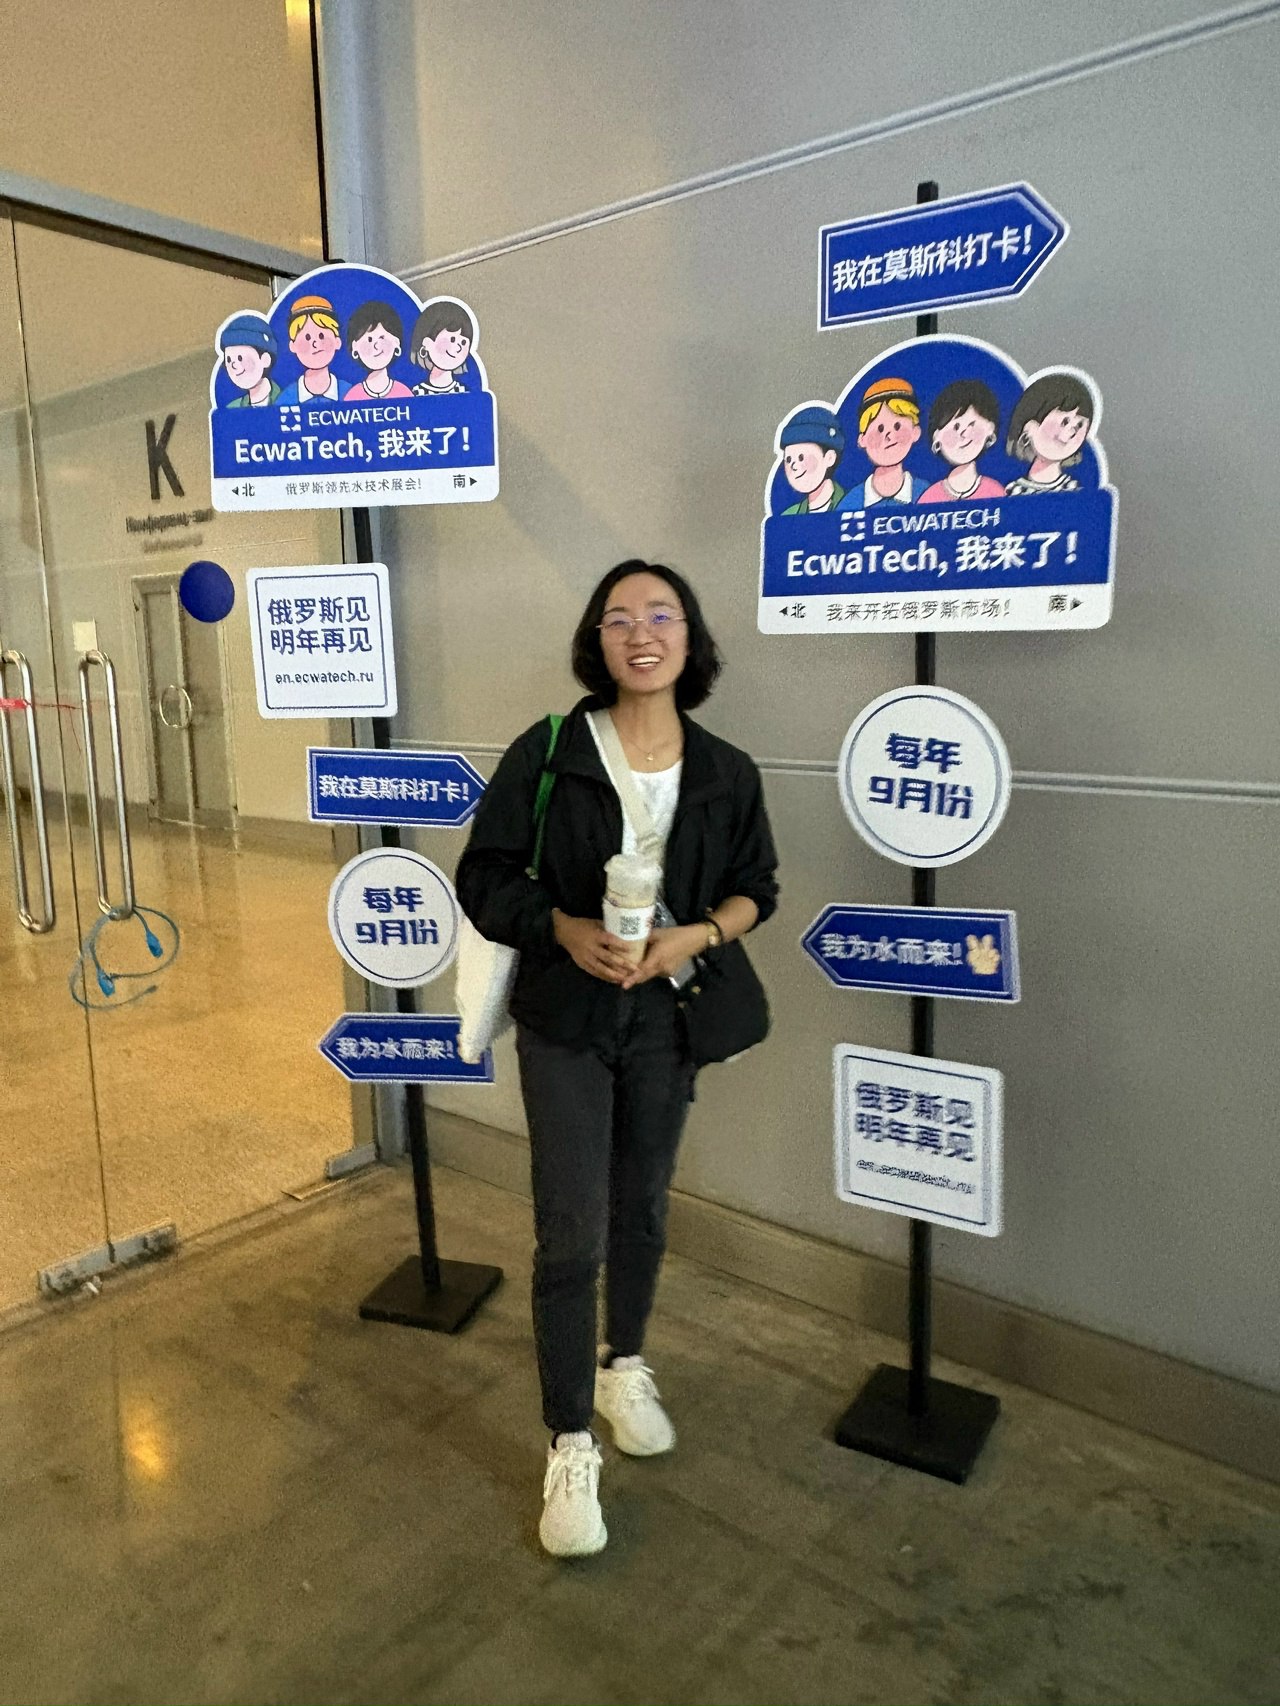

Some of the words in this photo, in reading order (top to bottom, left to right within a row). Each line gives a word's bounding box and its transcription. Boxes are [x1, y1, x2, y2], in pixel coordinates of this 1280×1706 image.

[308, 405, 410, 426] ECWATECH
[242, 482, 256, 497] 北
[452, 473, 467, 489] 南
[873, 507, 1001, 536] ECWATECH
[267, 596, 371, 625] 俄罗斯见
[270, 627, 372, 655] 明年再见
[275, 669, 374, 685] en.ecwatech.ru
[885, 732, 962, 774] 每年
[867, 776, 975, 820] 9月份
[363, 886, 424, 913] 每年
[355, 918, 439, 945] 9月份
